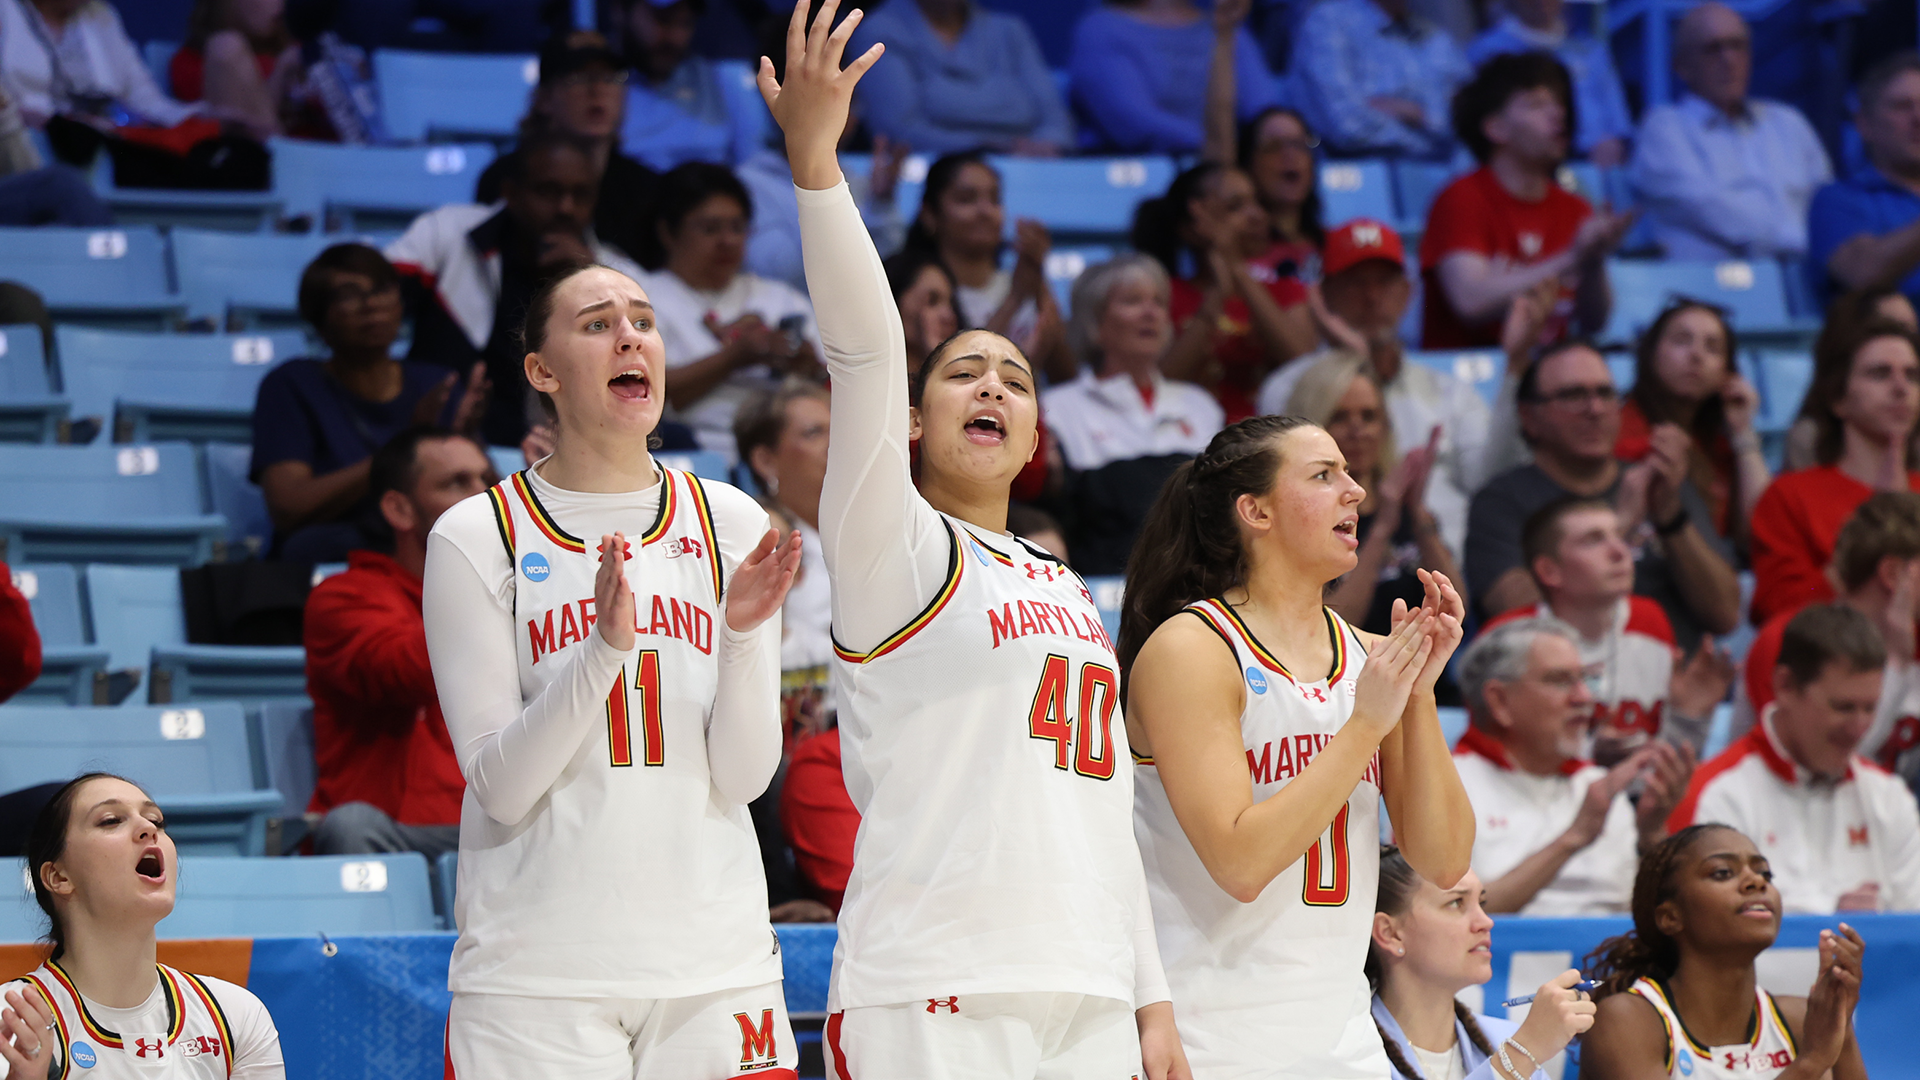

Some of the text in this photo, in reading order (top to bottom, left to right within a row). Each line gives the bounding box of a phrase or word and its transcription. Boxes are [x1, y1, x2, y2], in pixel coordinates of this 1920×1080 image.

[526, 565, 549, 575] NCAA
[528, 592, 712, 666] MARLAND
[606, 650, 664, 766] 11
[1030, 653, 1117, 782] 40
[357, 866, 371, 892] 2
[75, 1052, 95, 1063] NCAA
[733, 1008, 777, 1062] M
